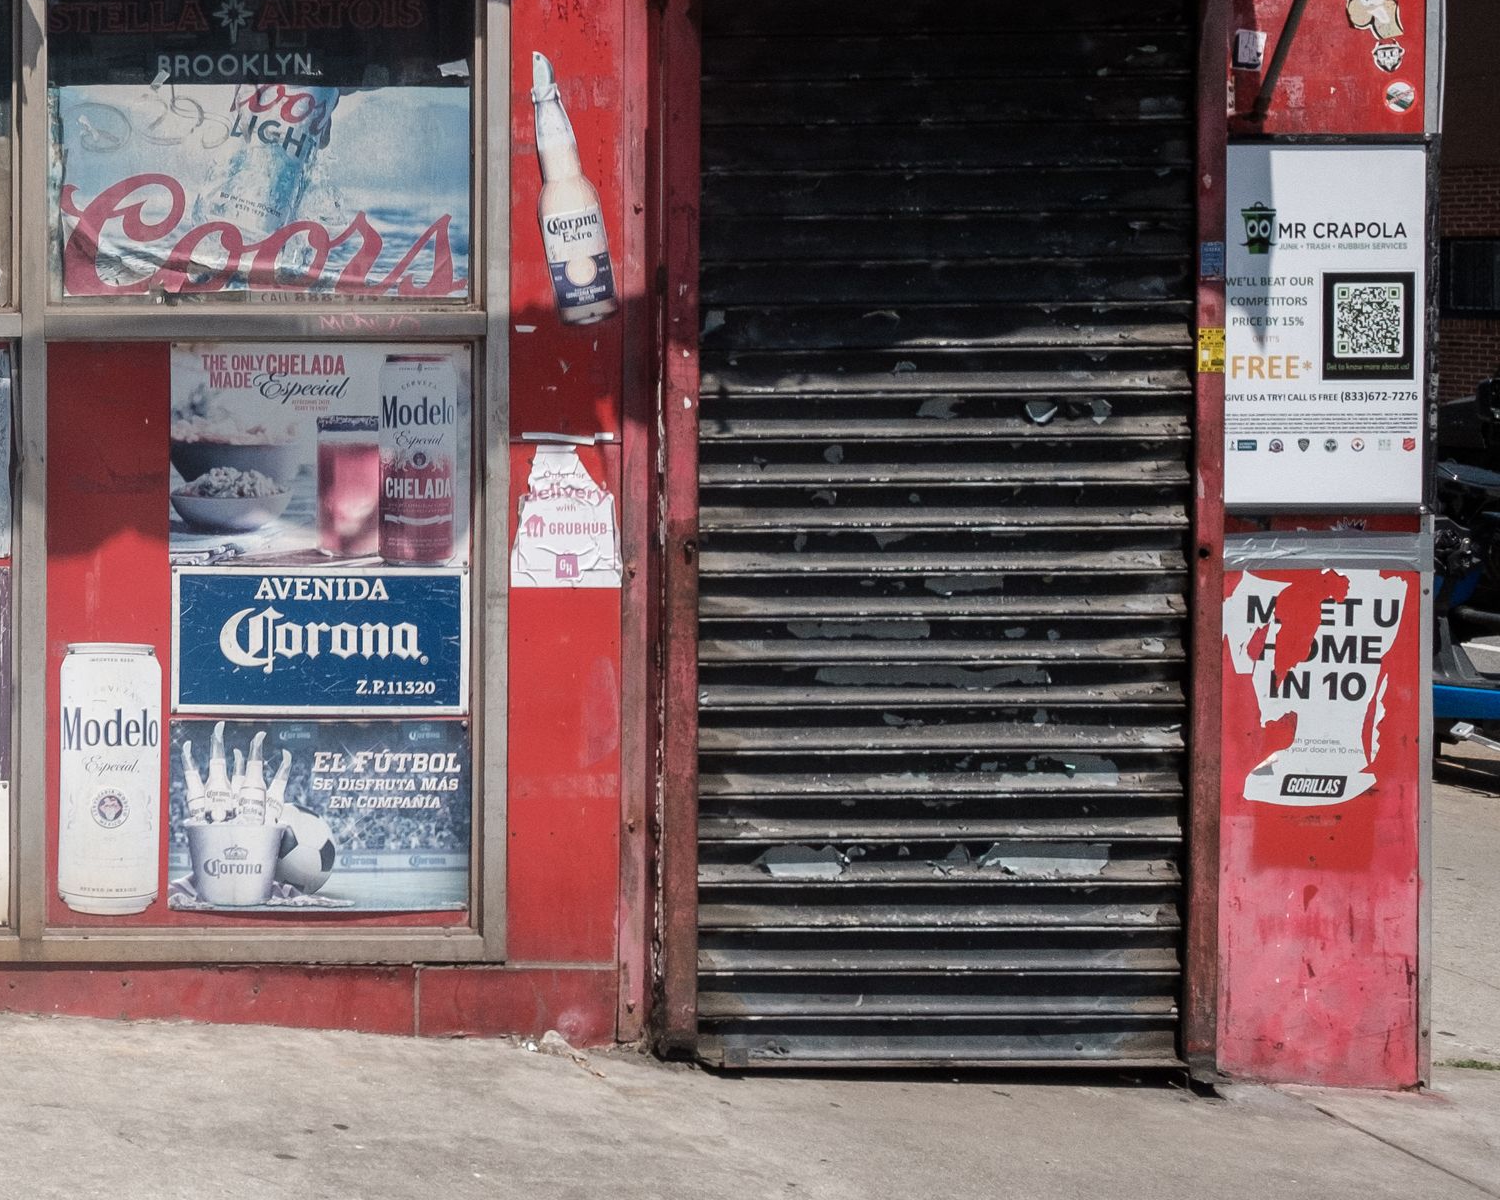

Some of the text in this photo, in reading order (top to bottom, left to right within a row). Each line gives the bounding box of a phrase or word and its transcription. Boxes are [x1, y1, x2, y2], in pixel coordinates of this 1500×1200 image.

[48, 0, 208, 34] STELLA
[158, 53, 312, 78] BROOKLYN
[546, 212, 598, 237] Corona
[1279, 221, 1408, 239] MR CRAPOLA
[61, 172, 469, 297] Coors
[562, 230, 593, 243] Extra
[1306, 242, 1331, 250] TRASH
[1338, 242, 1370, 250] RUBBISH
[1372, 242, 1408, 250] SERVICES
[1226, 276, 1314, 287] WE'LL BEAT OUR
[1230, 296, 1308, 307] COMPETITORS
[1232, 316, 1305, 327] PRICE BY 15%
[202, 354, 345, 375] THE ONLY CHELADA
[209, 371, 350, 404] MADE Especial
[1225, 391, 1418, 403] GIVE US A TRY! CALL IS FREE (833)672-7276
[382, 394, 454, 429] Modelo
[393, 430, 444, 449] Especial
[385, 477, 452, 499] CHELADA
[556, 503, 576, 512] with
[549, 522, 607, 535] GRUBHUB
[254, 577, 389, 601] AVENIDA
[1247, 595, 1399, 627] MET U
[219, 606, 422, 674] Corona
[1269, 670, 1367, 701] IN 10
[63, 706, 158, 752] Modelo
[279, 729, 312, 741] Corona
[408, 730, 440, 742] Corona
[1291, 746, 1307, 754] your
[83, 755, 140, 777] Especial
[312, 748, 461, 774] EL FÚTBOL
[312, 774, 459, 791] SE DISFRUTA MÁS
[1287, 778, 1340, 794] GORILLAS
[329, 793, 442, 809] EN COMPAÑÍA
[203, 858, 262, 879] Corona
[339, 854, 446, 867] Corona Corona
